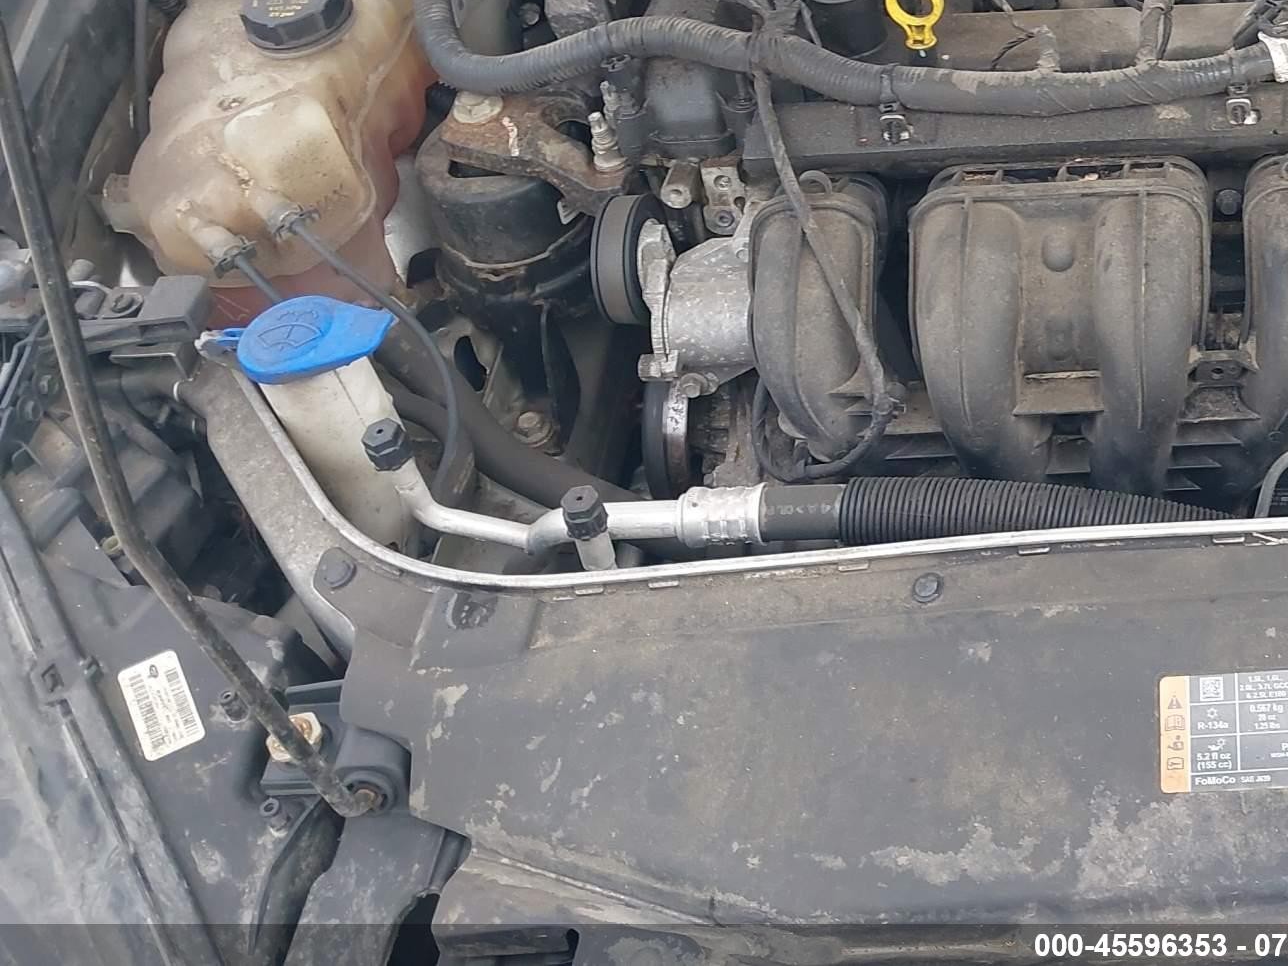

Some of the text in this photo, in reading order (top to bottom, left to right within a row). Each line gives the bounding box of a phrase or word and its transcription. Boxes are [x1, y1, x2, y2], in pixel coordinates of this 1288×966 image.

[1272, 703, 1284, 714] kg
[1197, 721, 1230, 730] R-134a
[1219, 752, 1232, 760] oz
[1197, 760, 1232, 771] (155 cc)
[1195, 775, 1236, 785] FoMoCo
